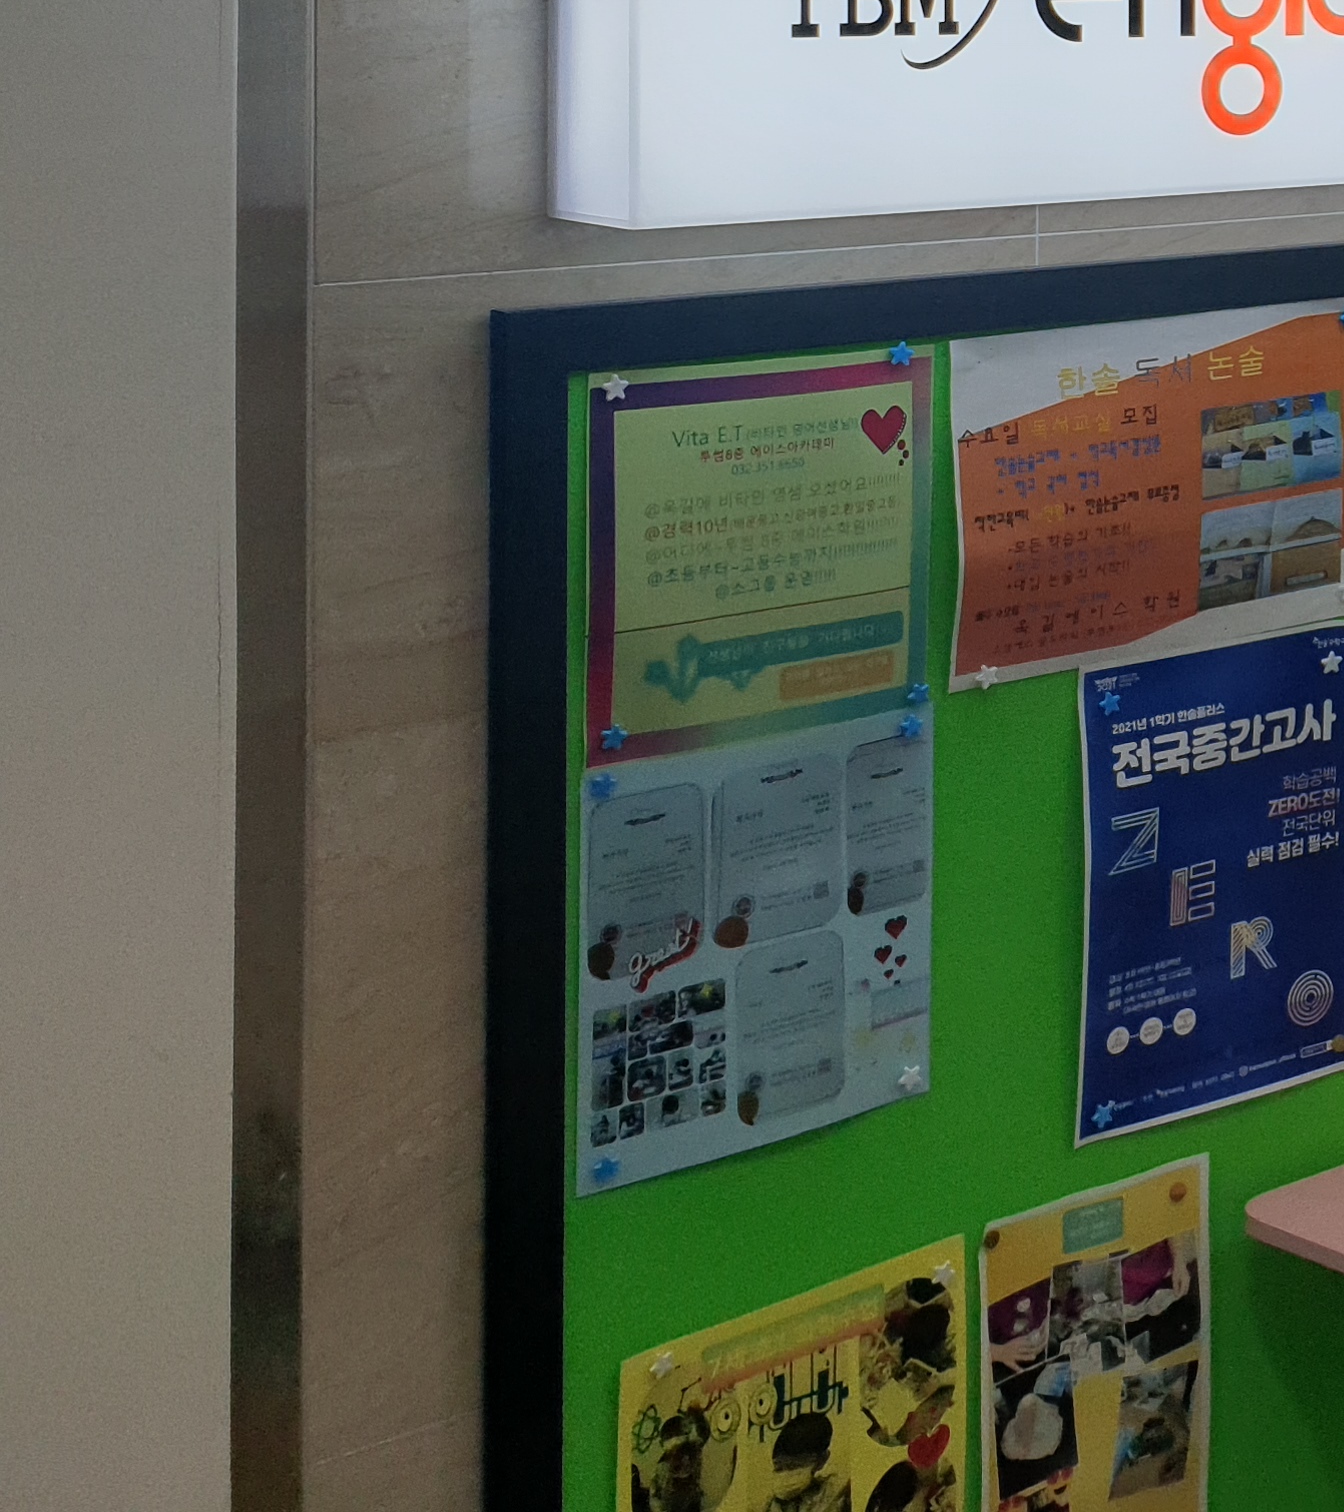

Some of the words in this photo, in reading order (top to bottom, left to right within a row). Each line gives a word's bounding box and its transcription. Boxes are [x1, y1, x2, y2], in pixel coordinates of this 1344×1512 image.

[1057, 362, 1121, 401] 한솔
[1207, 345, 1265, 381] 논술
[1120, 404, 1159, 426] 모집
[672, 430, 709, 448] Vita
[1112, 717, 1146, 735] 2021년
[1149, 712, 1175, 728] 1학기
[1111, 698, 1337, 788] 전국중간고사
[1282, 809, 1336, 837] 전국단위
[1246, 846, 1274, 868] 실력
[1307, 831, 1340, 854] 필수!
